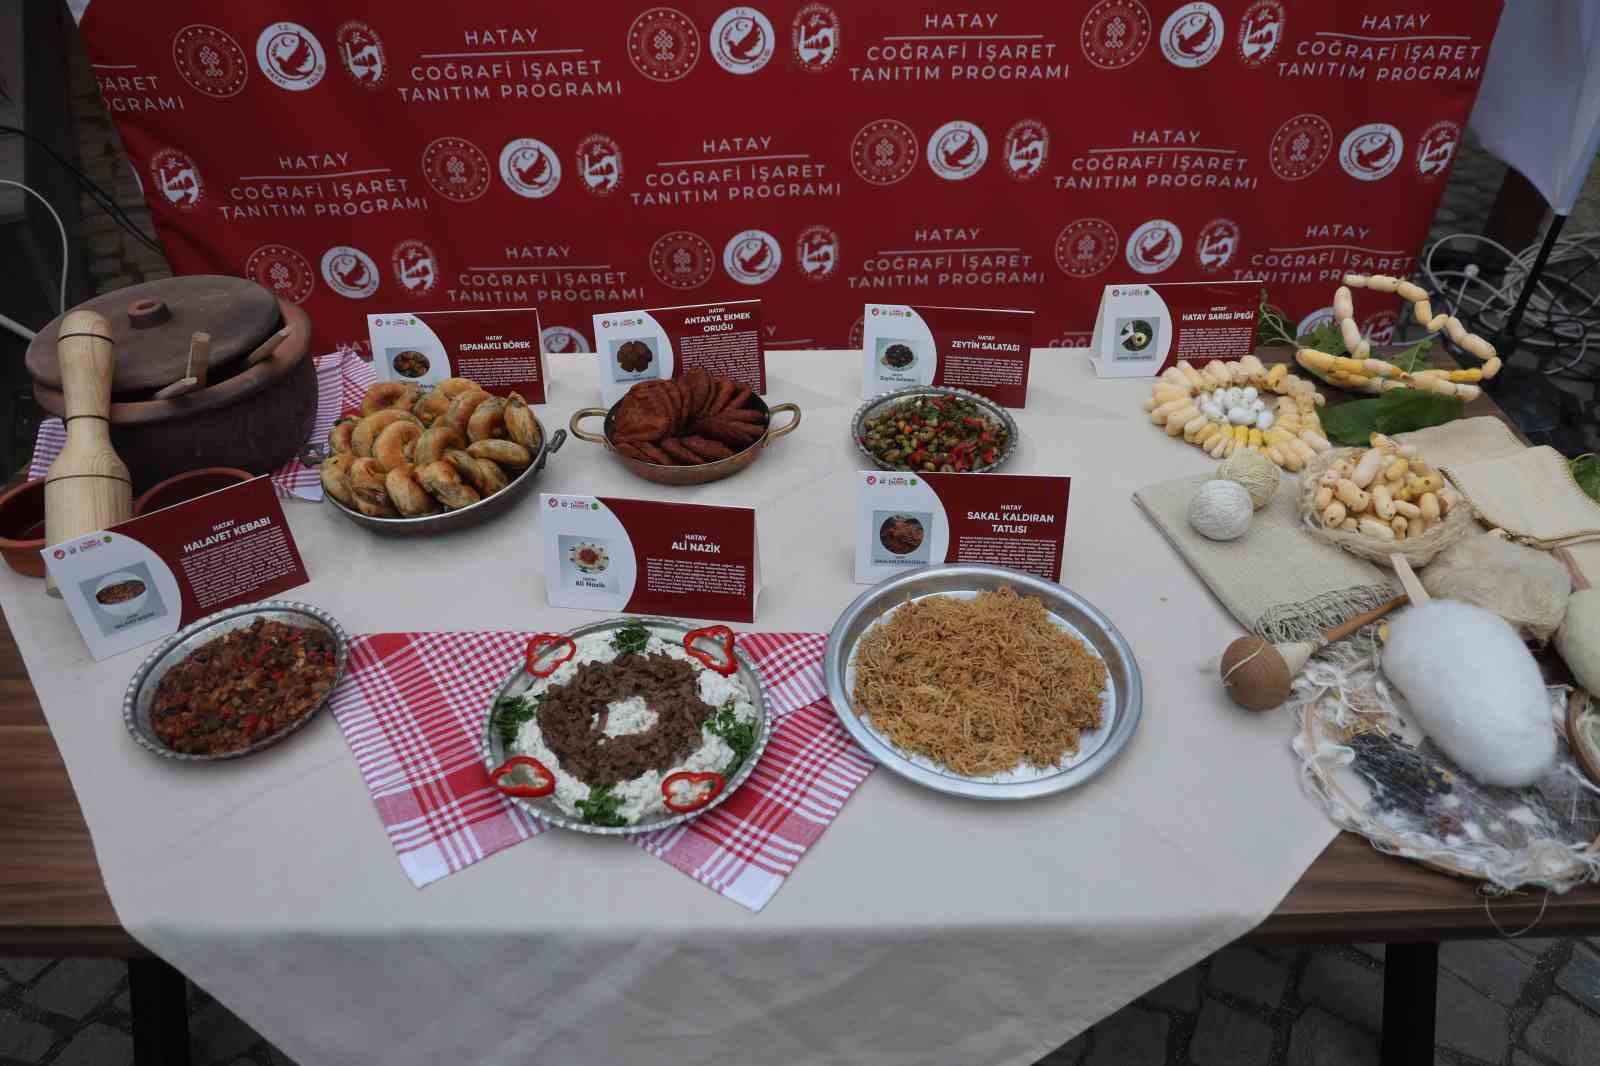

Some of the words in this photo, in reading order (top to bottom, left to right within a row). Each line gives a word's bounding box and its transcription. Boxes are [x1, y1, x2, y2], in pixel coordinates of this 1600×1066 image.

[926, 13, 999, 28] HATAY
[1361, 14, 1431, 30] HATAY
[465, 28, 538, 46] HATAY
[867, 41, 966, 61] COĞRAFİ
[978, 43, 1056, 62] İŞARET
[1297, 40, 1396, 61] COĞRAFİ
[1404, 44, 1481, 64] İŞARET
[411, 62, 512, 81] COĞRAFİ
[523, 60, 602, 81] İŞARET
[849, 66, 940, 82] TANITIM
[952, 64, 1070, 80] PROGRAMI
[1278, 62, 1366, 80] TANITIM
[1376, 66, 1481, 81] PROGRAM
[96, 76, 159, 92] ARET
[398, 85, 490, 102] TANITIM
[501, 80, 622, 98] PROGRAMI
[703, 136, 772, 153] HATAY
[1132, 130, 1200, 144] HATAY
[279, 152, 349, 169] HATAY
[1072, 153, 1163, 171] COĞRAFİ
[1173, 154, 1248, 172] İŞARET
[646, 166, 741, 187] COĞRAFİ
[752, 164, 826, 183] İŞARET
[1053, 175, 1136, 190] TANITIM
[1147, 174, 1258, 190] PROGRAMI
[231, 184, 323, 201] COĞRAFİ
[333, 178, 408, 200] İŞARET
[630, 189, 718, 207] TANITIM
[729, 183, 841, 200] PROGRAMI
[218, 203, 307, 220] TANITIM
[315, 197, 429, 216] PROGRAMI
[915, 228, 980, 242] HATAY
[1305, 224, 1370, 240] HATAY
[505, 245, 571, 260] HATAY
[1251, 250, 1335, 268] COĞRAFİ
[1344, 251, 1413, 271] İŞARET
[863, 256, 952, 273] COĞRAFİ
[962, 254, 1032, 271] İŞARET
[459, 271, 548, 288] COĞRAFİ
[557, 271, 627, 289] İŞARET
[848, 275, 928, 290] TANITIM
[938, 272, 1046, 287] PROGRAMI
[1232, 269, 1312, 284] TANITIM
[447, 289, 528, 303] TANITIM
[537, 288, 644, 302] PROGRAMI
[684, 314, 723, 325] ANTAKYA
[723, 312, 751, 321] EKMEK
[1182, 313, 1207, 321] HATAY
[703, 322, 734, 333] ORUĞU
[459, 342, 502, 351] ISPANAKLI
[503, 340, 531, 350] BÖREK
[951, 340, 980, 350] ZEYTİN
[981, 342, 1021, 353] SALATASI
[967, 511, 1000, 521] SAKAL
[1002, 513, 1055, 523] KALDIRAN
[183, 531, 232, 553] HALAVET
[233, 516, 272, 537] KEBABI
[991, 524, 1028, 534] TATLISI
[671, 541, 688, 551] ALİ
[689, 542, 721, 554] NAZİK
